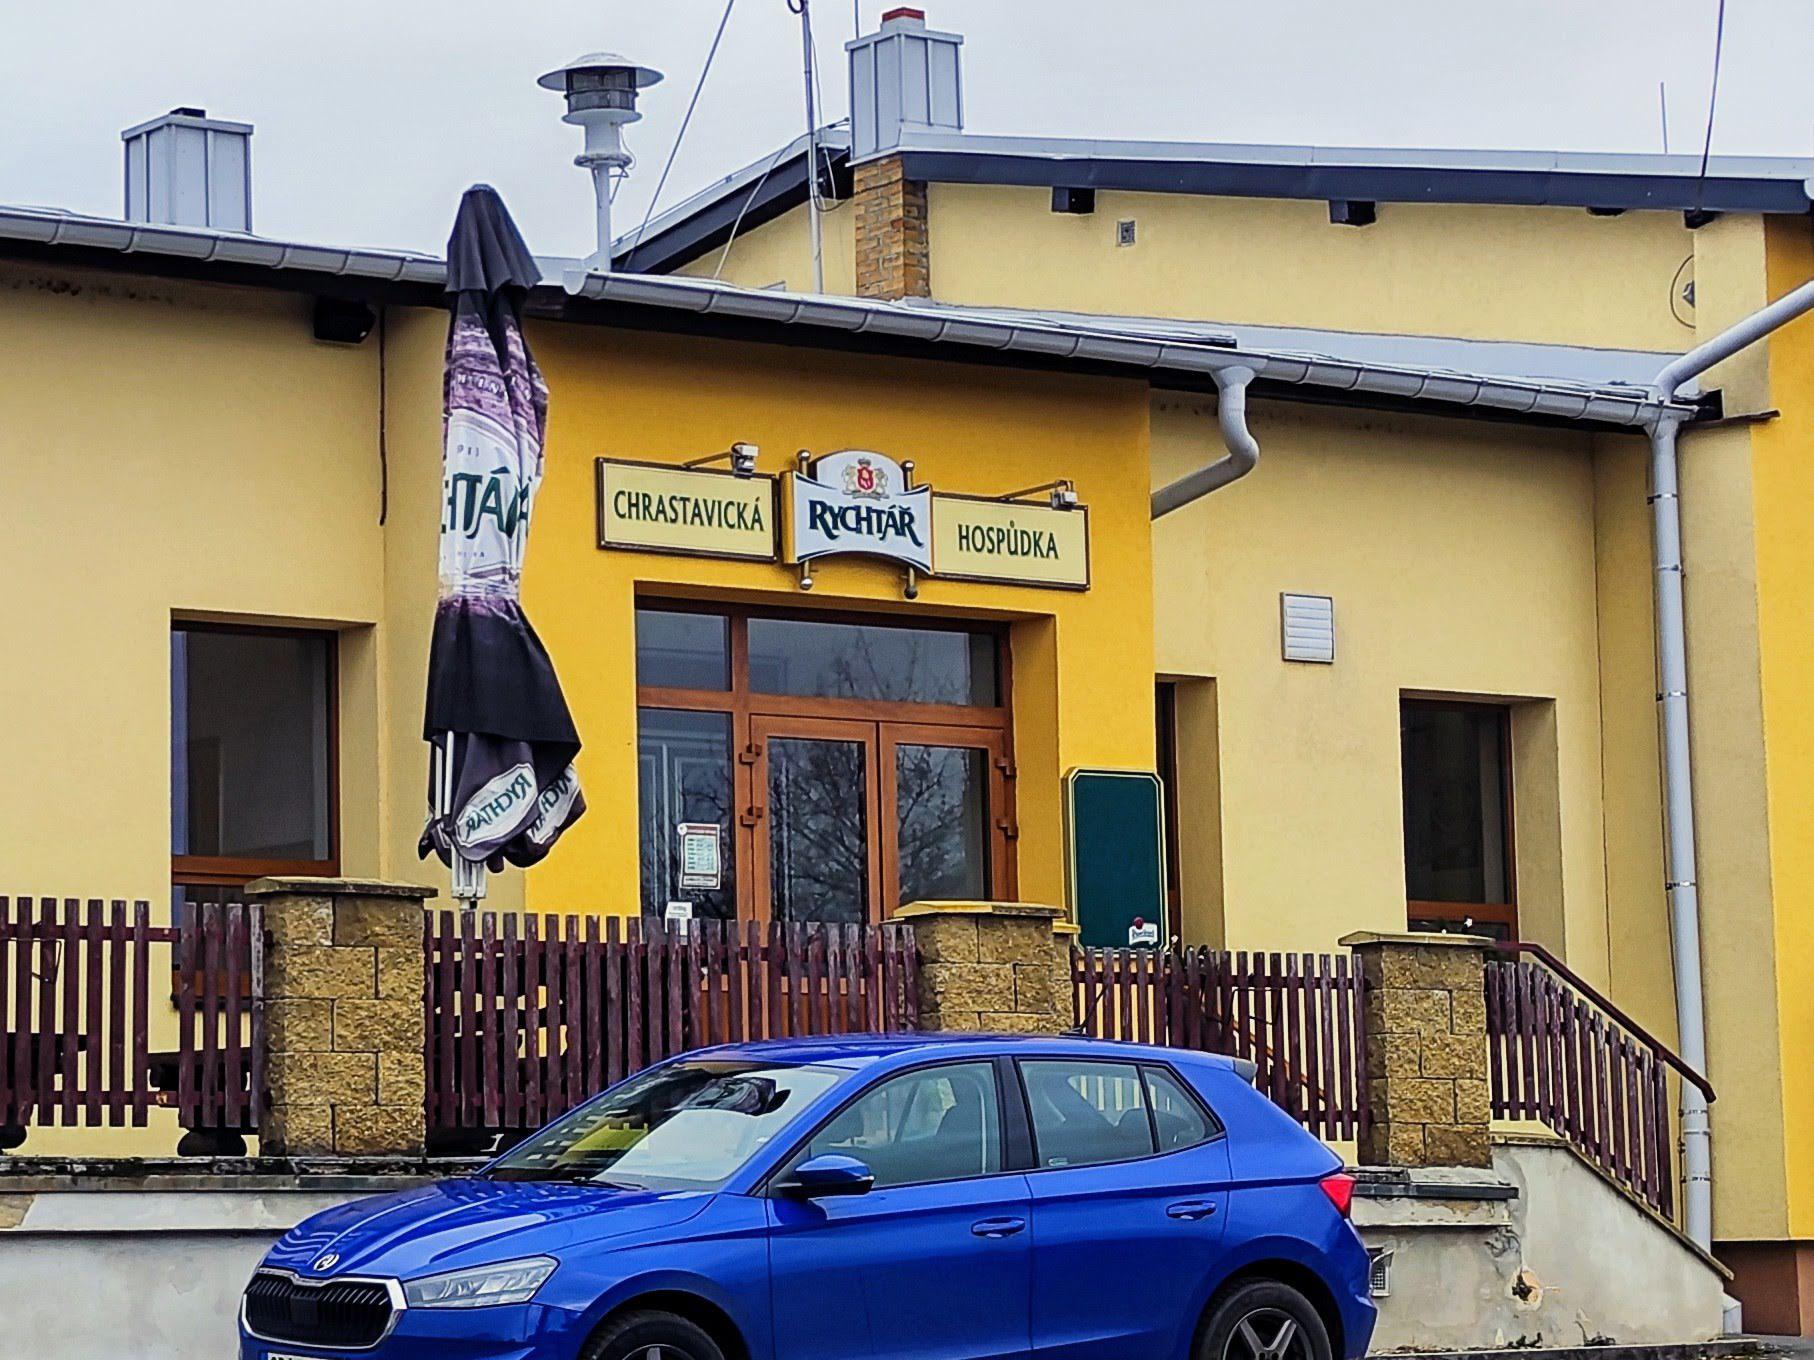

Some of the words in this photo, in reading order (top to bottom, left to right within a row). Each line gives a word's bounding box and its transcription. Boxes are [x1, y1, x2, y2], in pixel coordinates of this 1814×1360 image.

[613, 489, 765, 532] CHRASTAVICKÁ
[808, 499, 925, 549] RYCHTÁŘ
[957, 520, 1060, 560] HOSPŮDKA
